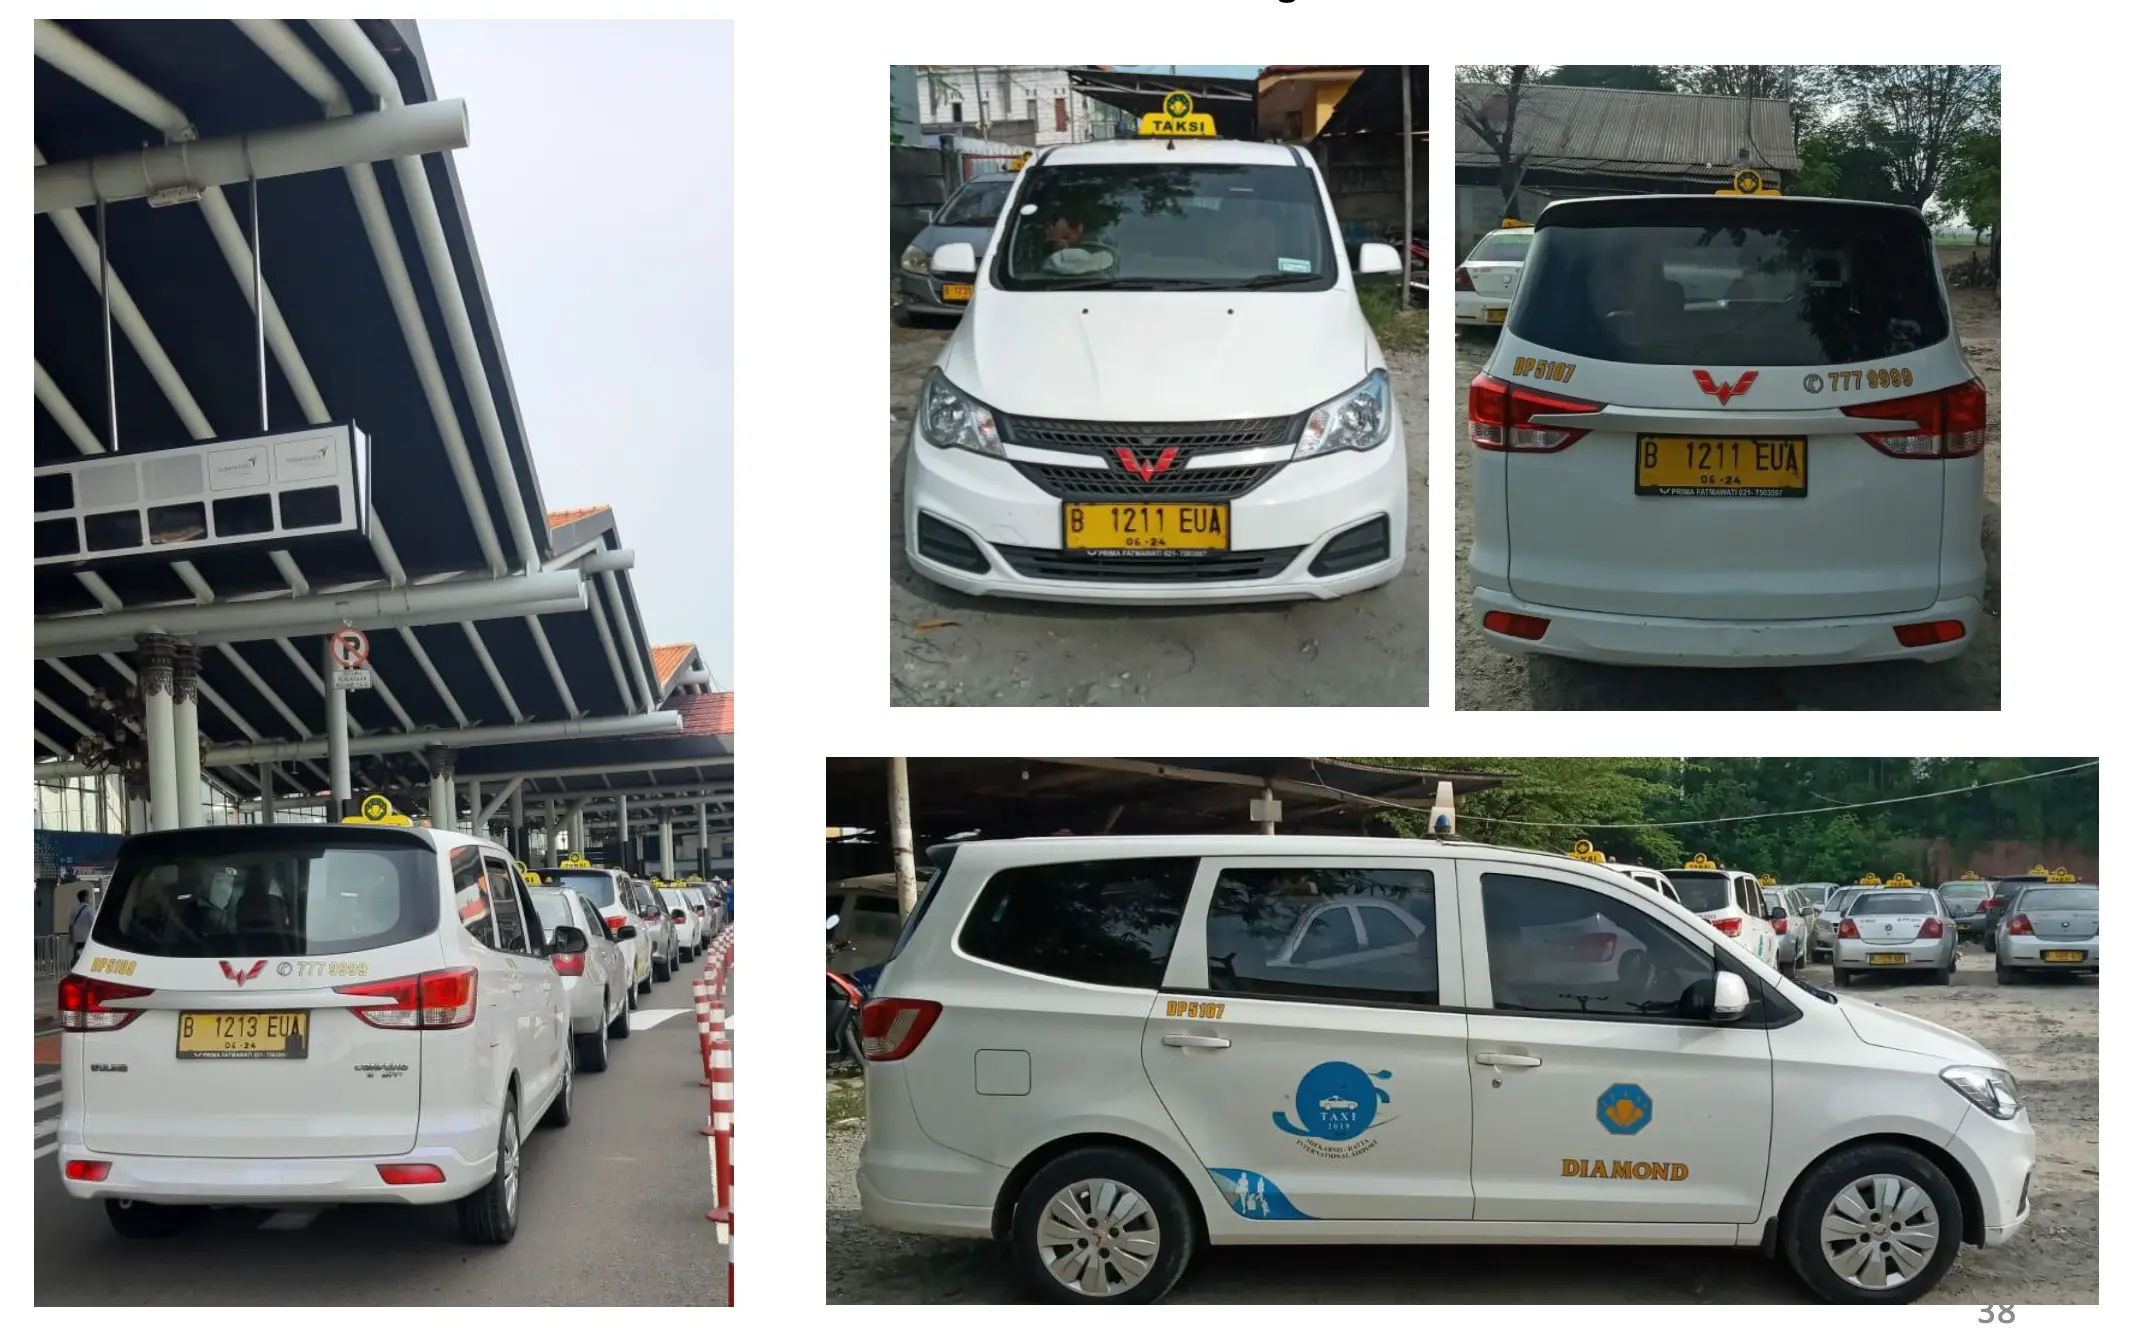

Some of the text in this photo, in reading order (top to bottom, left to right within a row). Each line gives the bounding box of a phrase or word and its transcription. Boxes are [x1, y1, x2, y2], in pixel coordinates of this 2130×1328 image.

[1152, 120, 1204, 132] TAKSI
[1512, 356, 1576, 383] DP5107
[1828, 367, 1914, 392] 777 9999
[1644, 442, 1799, 472] B 1211 EUA
[1696, 488, 1738, 496] FATMAWATI
[1071, 508, 1221, 533] B 1211 EUA
[297, 961, 370, 977] 777 9999
[1167, 1000, 1226, 1019] DP5107
[183, 1016, 300, 1038] B 1213 EUA
[1320, 1112, 1357, 1122] TAXI
[1561, 1158, 1689, 1182] DIAMOND
